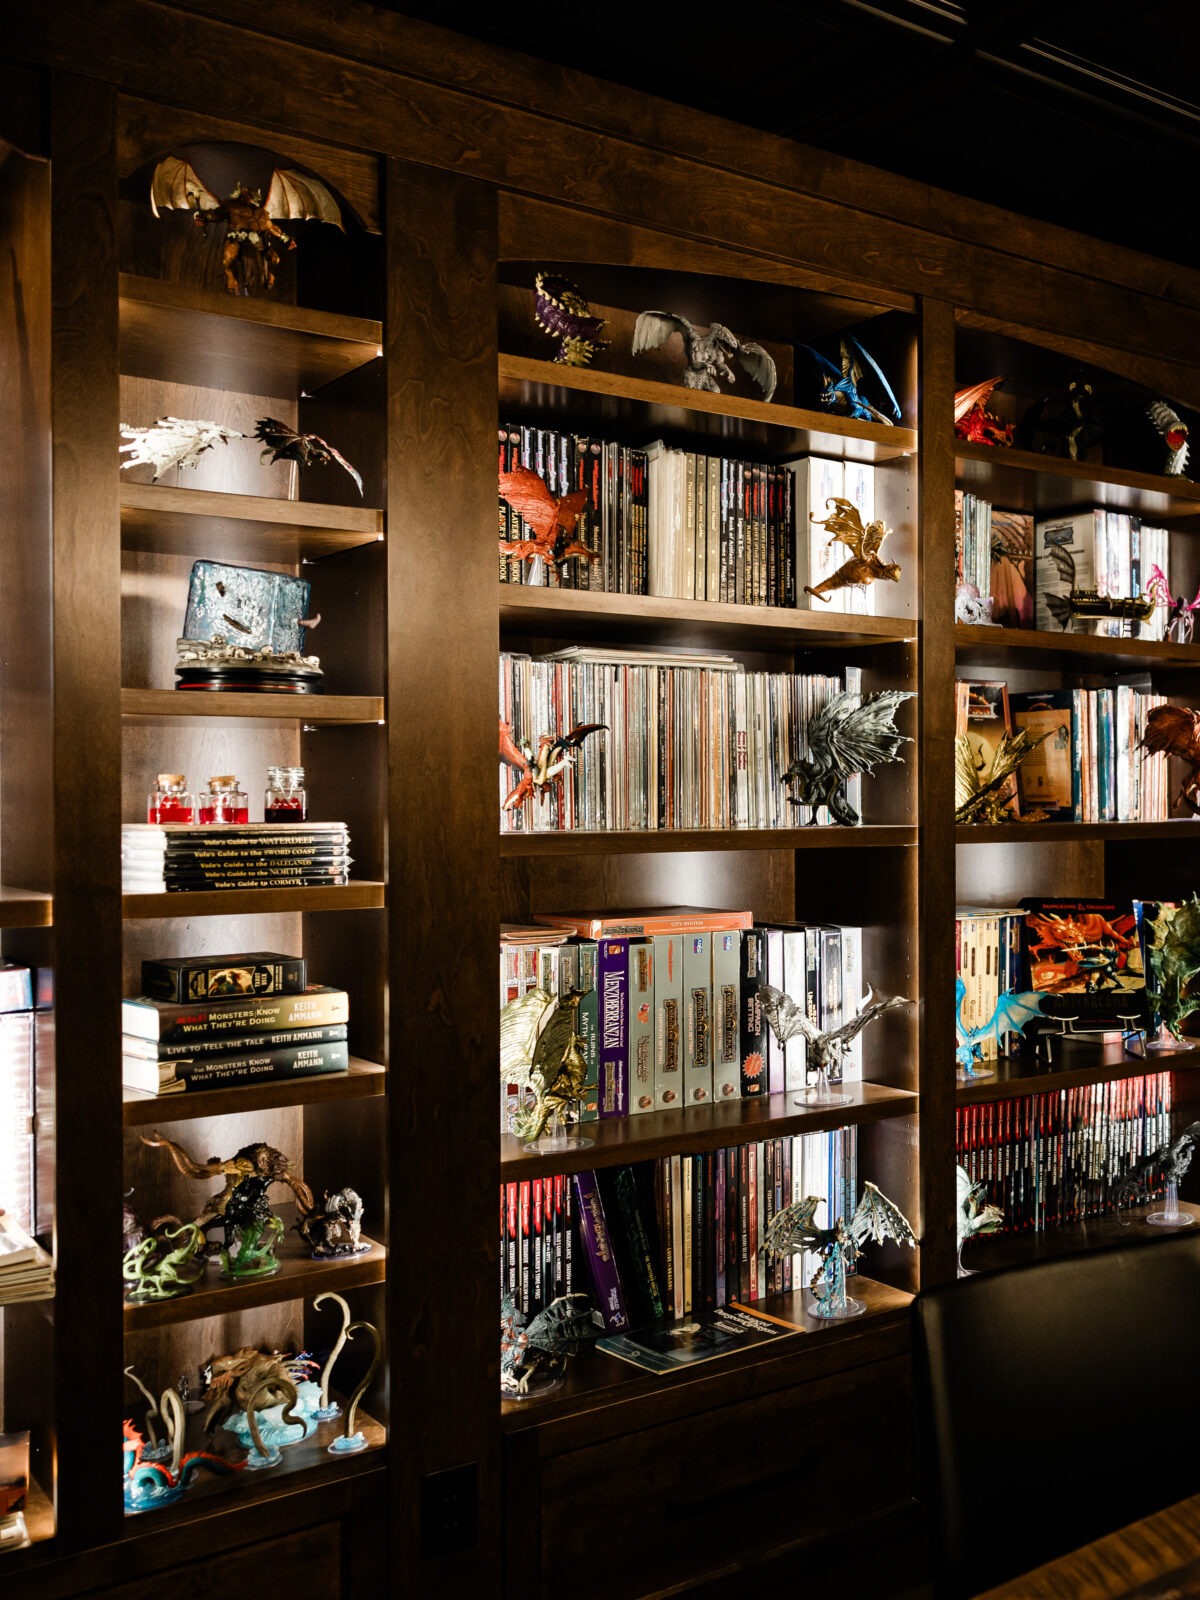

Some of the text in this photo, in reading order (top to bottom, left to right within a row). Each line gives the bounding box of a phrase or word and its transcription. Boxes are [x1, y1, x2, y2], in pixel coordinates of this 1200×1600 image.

[259, 837, 315, 845] WATERDEEP
[269, 859, 312, 867] DALELANDS
[269, 878, 301, 886] CORMYR
[1077, 903, 1086, 911] &
[294, 1001, 317, 1011] KEITH
[604, 971, 624, 1049] MENZOBERRANZAN
[208, 1007, 281, 1021] MONSTERS KNOW
[288, 1010, 323, 1022] AMMANN
[183, 1016, 276, 1033] WHAT THEY'RE DOING
[271, 1030, 323, 1043] KEITH AMMANN
[167, 1047, 187, 1055] LIVE
[203, 1042, 225, 1051] TELL
[226, 1040, 242, 1048] THE
[245, 1038, 264, 1047] TALE
[297, 1049, 319, 1060] KEITH
[206, 1060, 247, 1072] MONSTERS
[249, 1057, 271, 1066] KNOW
[293, 1058, 324, 1069] AMMANN
[191, 1065, 274, 1081] WHAT THEY'RE DOING
